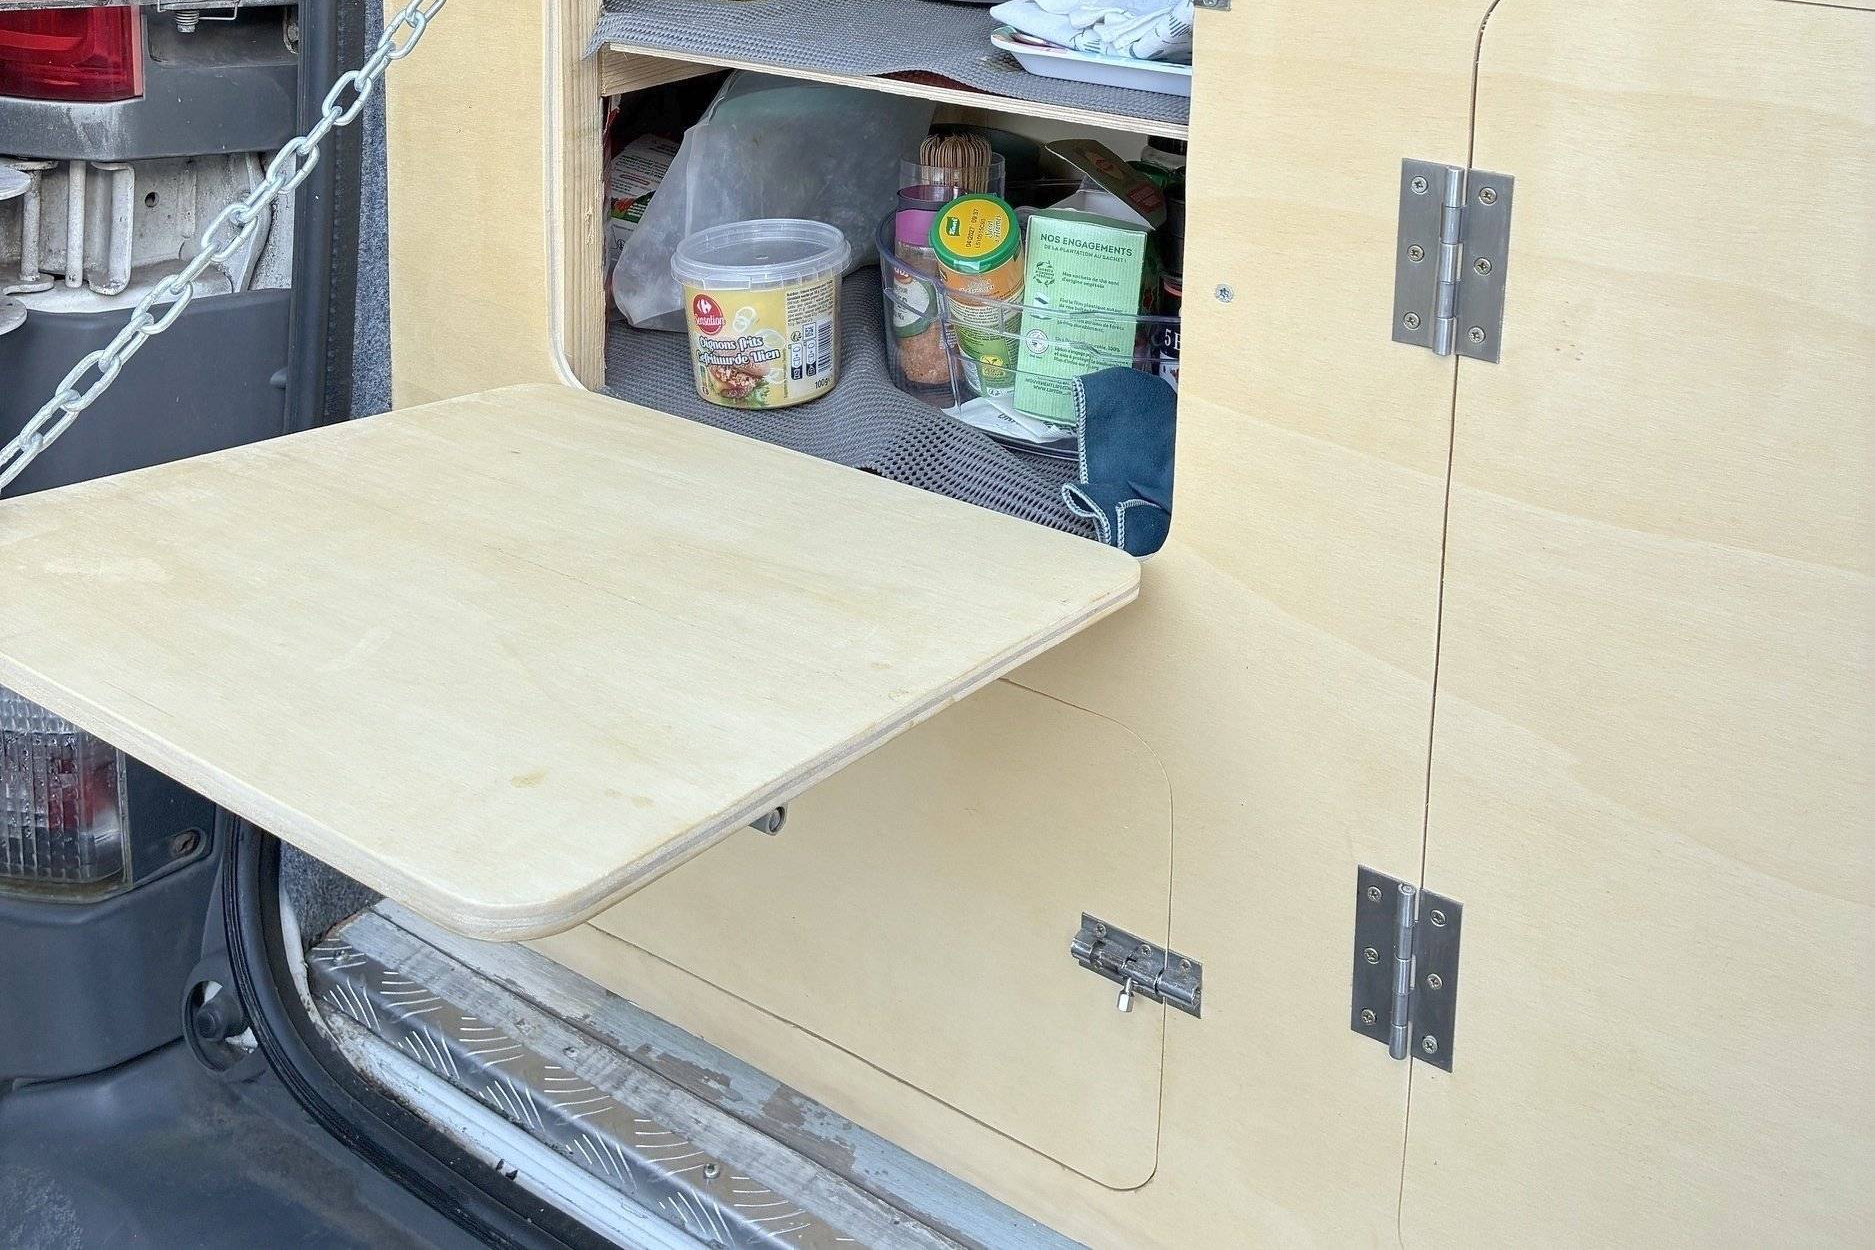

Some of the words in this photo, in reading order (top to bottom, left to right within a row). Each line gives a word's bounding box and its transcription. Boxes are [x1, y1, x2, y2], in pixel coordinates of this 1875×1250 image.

[1040, 233, 1061, 244] NOS
[1062, 237, 1133, 257] ENGAGEMENTS
[1060, 247, 1093, 258] PLANTATION
[699, 335, 736, 353] Oignons
[737, 335, 763, 353] frits
[1164, 328, 1172, 347] 5
